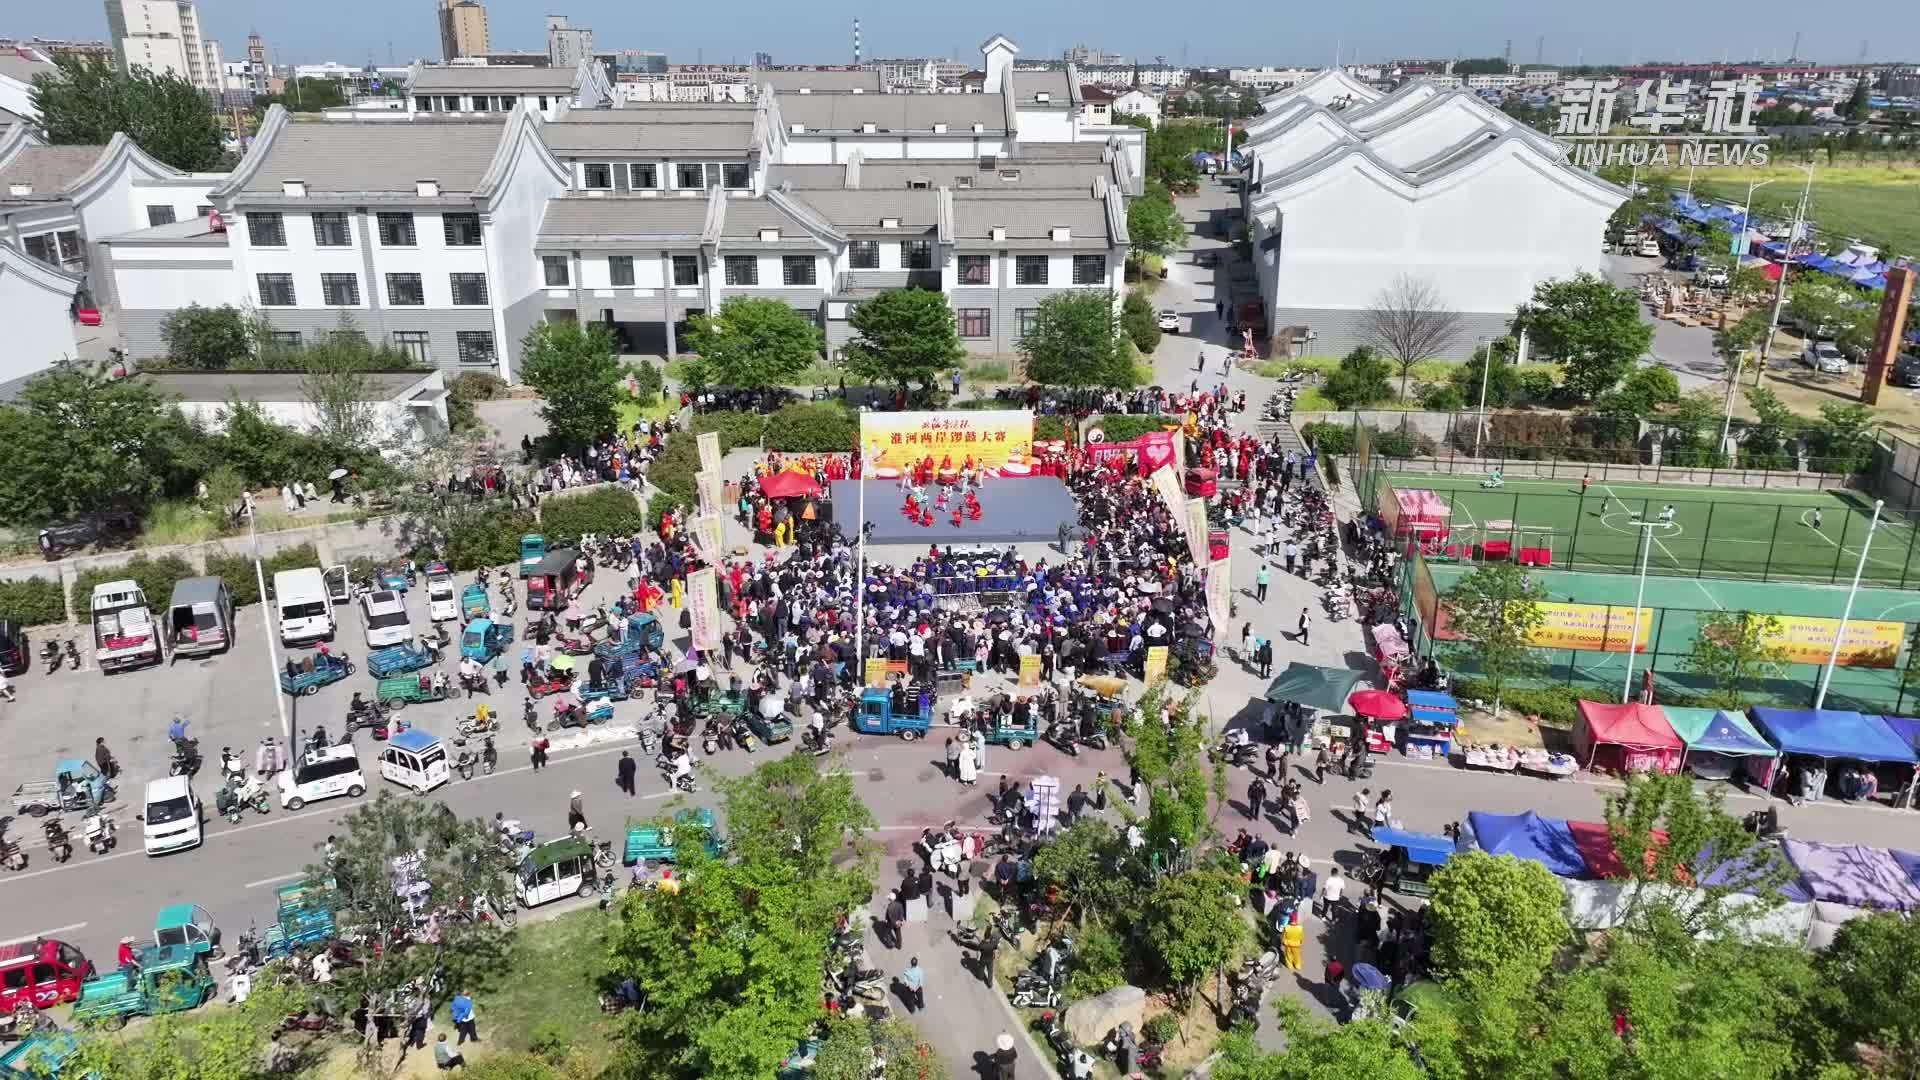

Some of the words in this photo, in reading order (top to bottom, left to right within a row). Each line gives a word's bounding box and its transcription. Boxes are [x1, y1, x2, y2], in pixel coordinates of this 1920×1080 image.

[891, 432, 1006, 444] 淮河两岸锣鼓大赛
